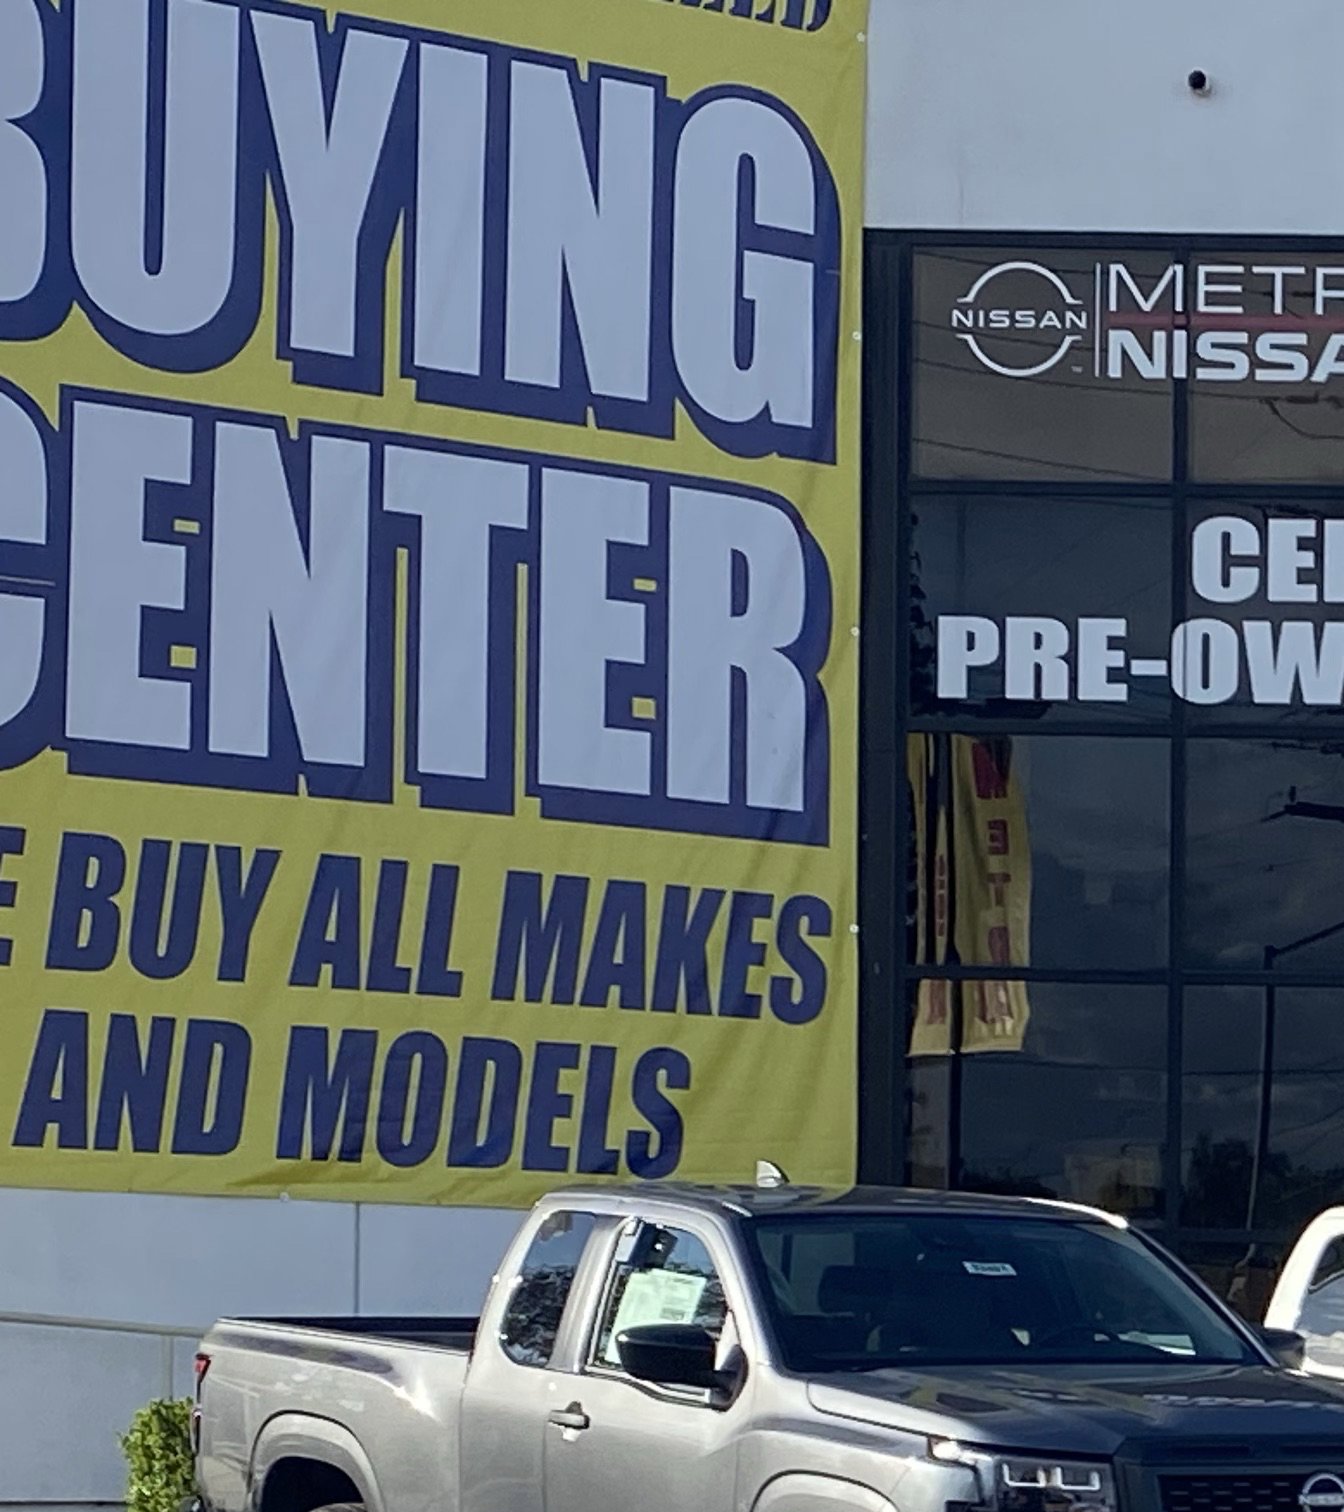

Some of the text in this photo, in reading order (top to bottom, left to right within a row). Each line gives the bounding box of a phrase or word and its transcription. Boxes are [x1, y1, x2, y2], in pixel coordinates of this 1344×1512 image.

[0, 0, 816, 429] UYING
[951, 307, 1088, 330] NISSAN
[0, 388, 807, 812] ENTER
[44, 832, 283, 984] BUY
[288, 852, 465, 999] ALL
[490, 869, 834, 1026] MAKES
[11, 1009, 692, 1180] AND MODELS
